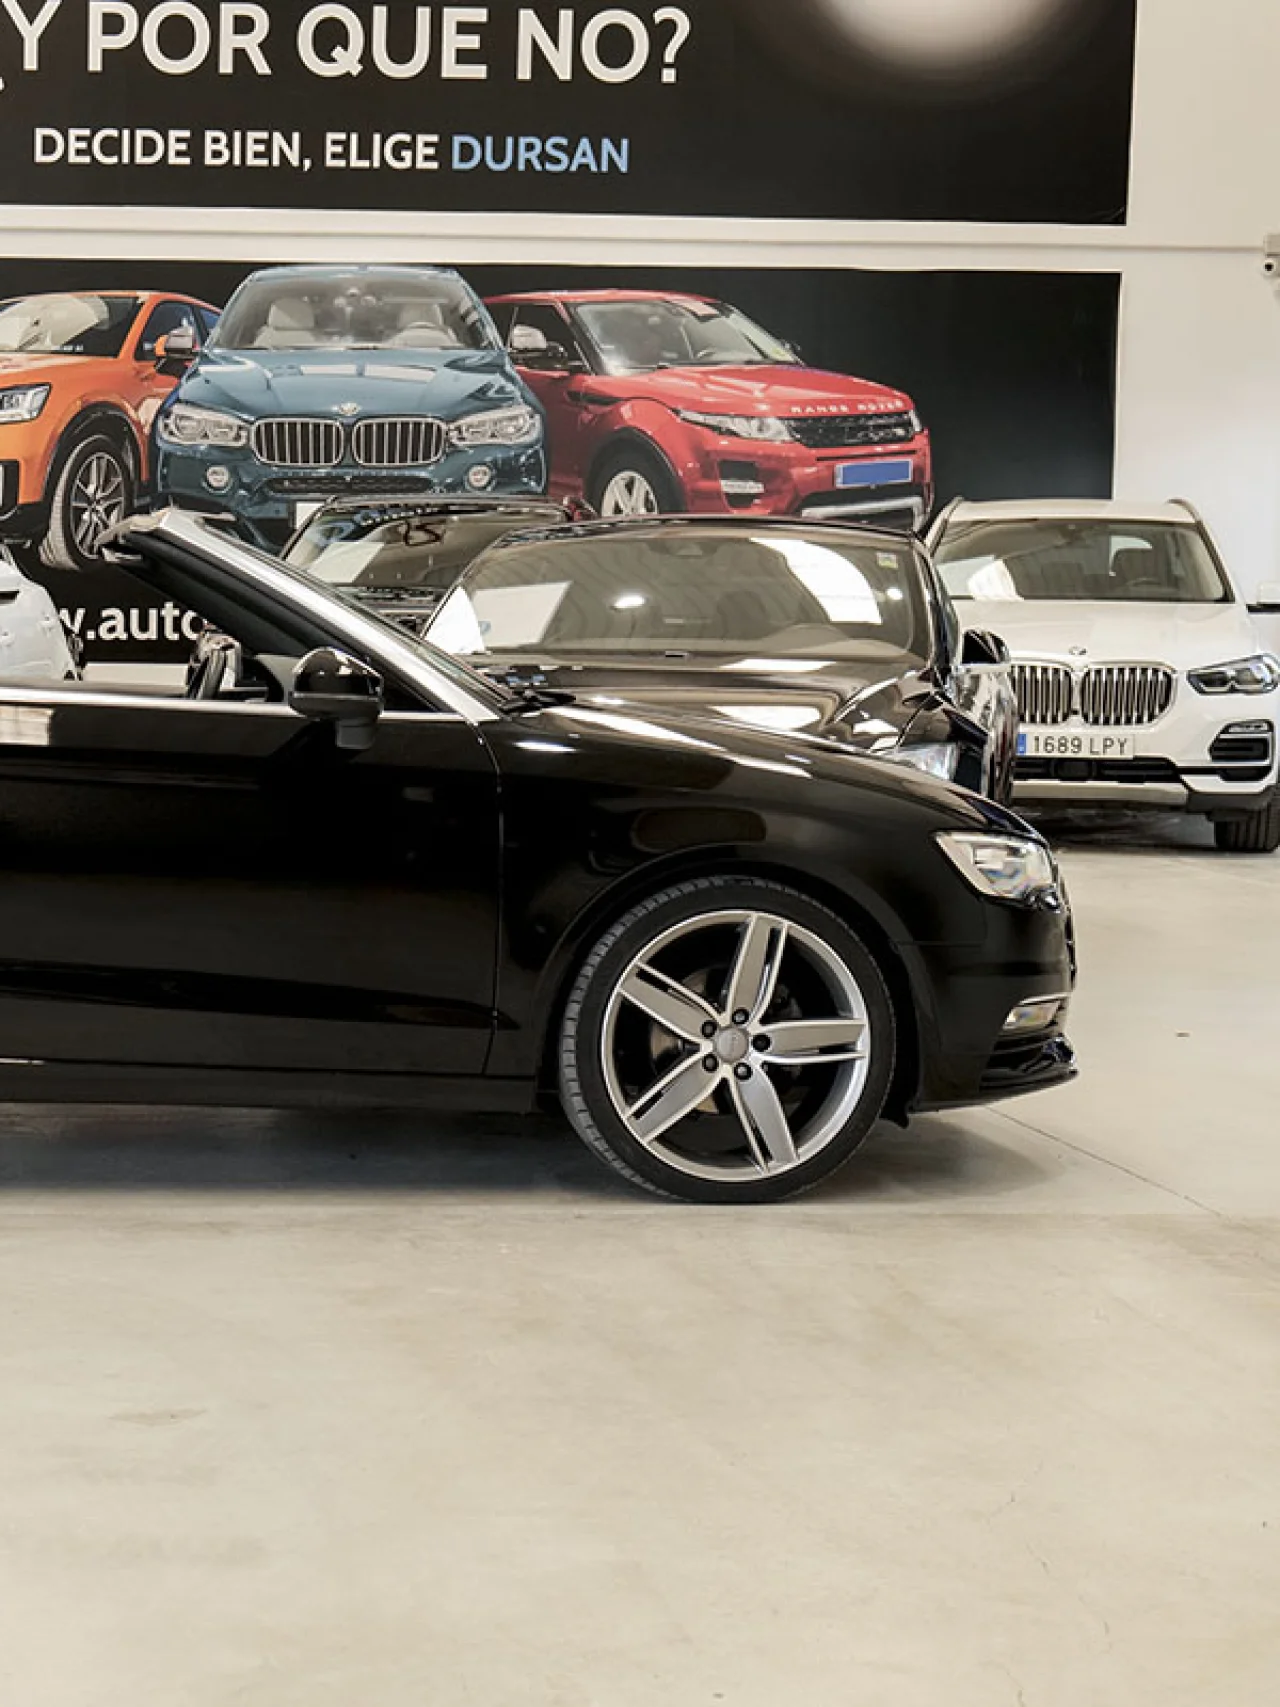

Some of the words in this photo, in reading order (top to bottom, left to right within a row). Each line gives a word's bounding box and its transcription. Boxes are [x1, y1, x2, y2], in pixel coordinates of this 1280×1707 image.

[86, 0, 272, 76] POR
[297, 3, 488, 79] QUE
[516, 6, 691, 84] NO?
[33, 127, 192, 166] DECIDE
[204, 130, 312, 172] BIEN,
[325, 133, 439, 170] ELIGE
[451, 135, 629, 174] DURSAN
[1034, 735, 1082, 754] 1689
[1089, 737, 1128, 756] LPY
